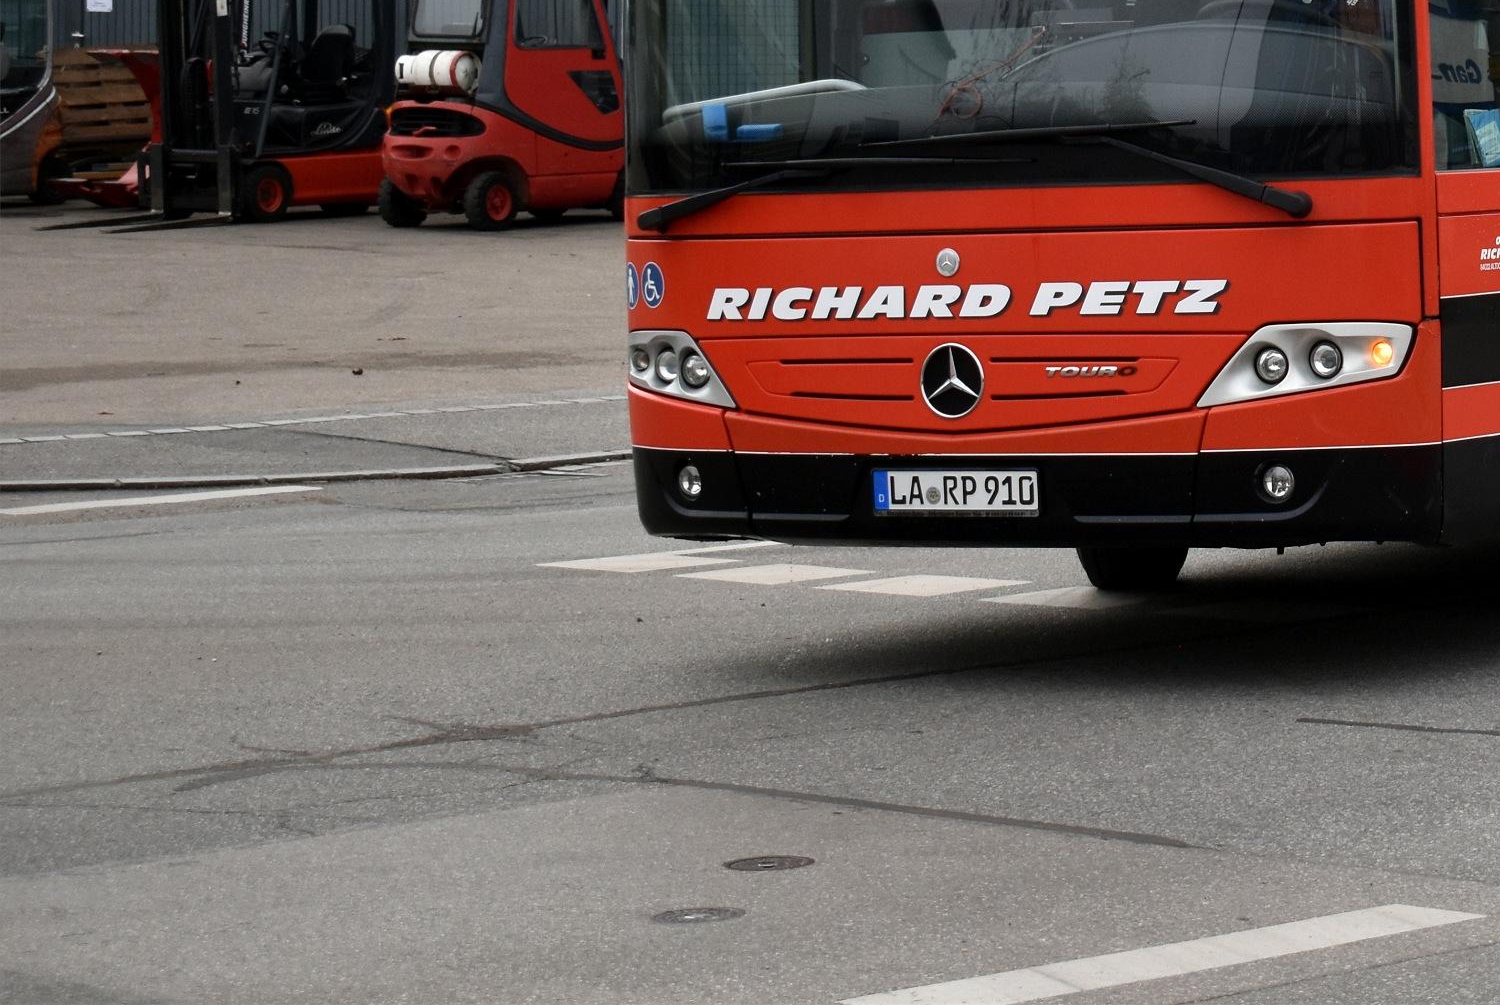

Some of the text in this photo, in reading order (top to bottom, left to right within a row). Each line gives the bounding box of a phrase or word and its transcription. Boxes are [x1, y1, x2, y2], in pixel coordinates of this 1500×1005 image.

[706, 279, 1229, 322] RICHARD PETZ
[1045, 366, 1138, 378] TOURO
[878, 475, 1035, 505] D LA RP 910
